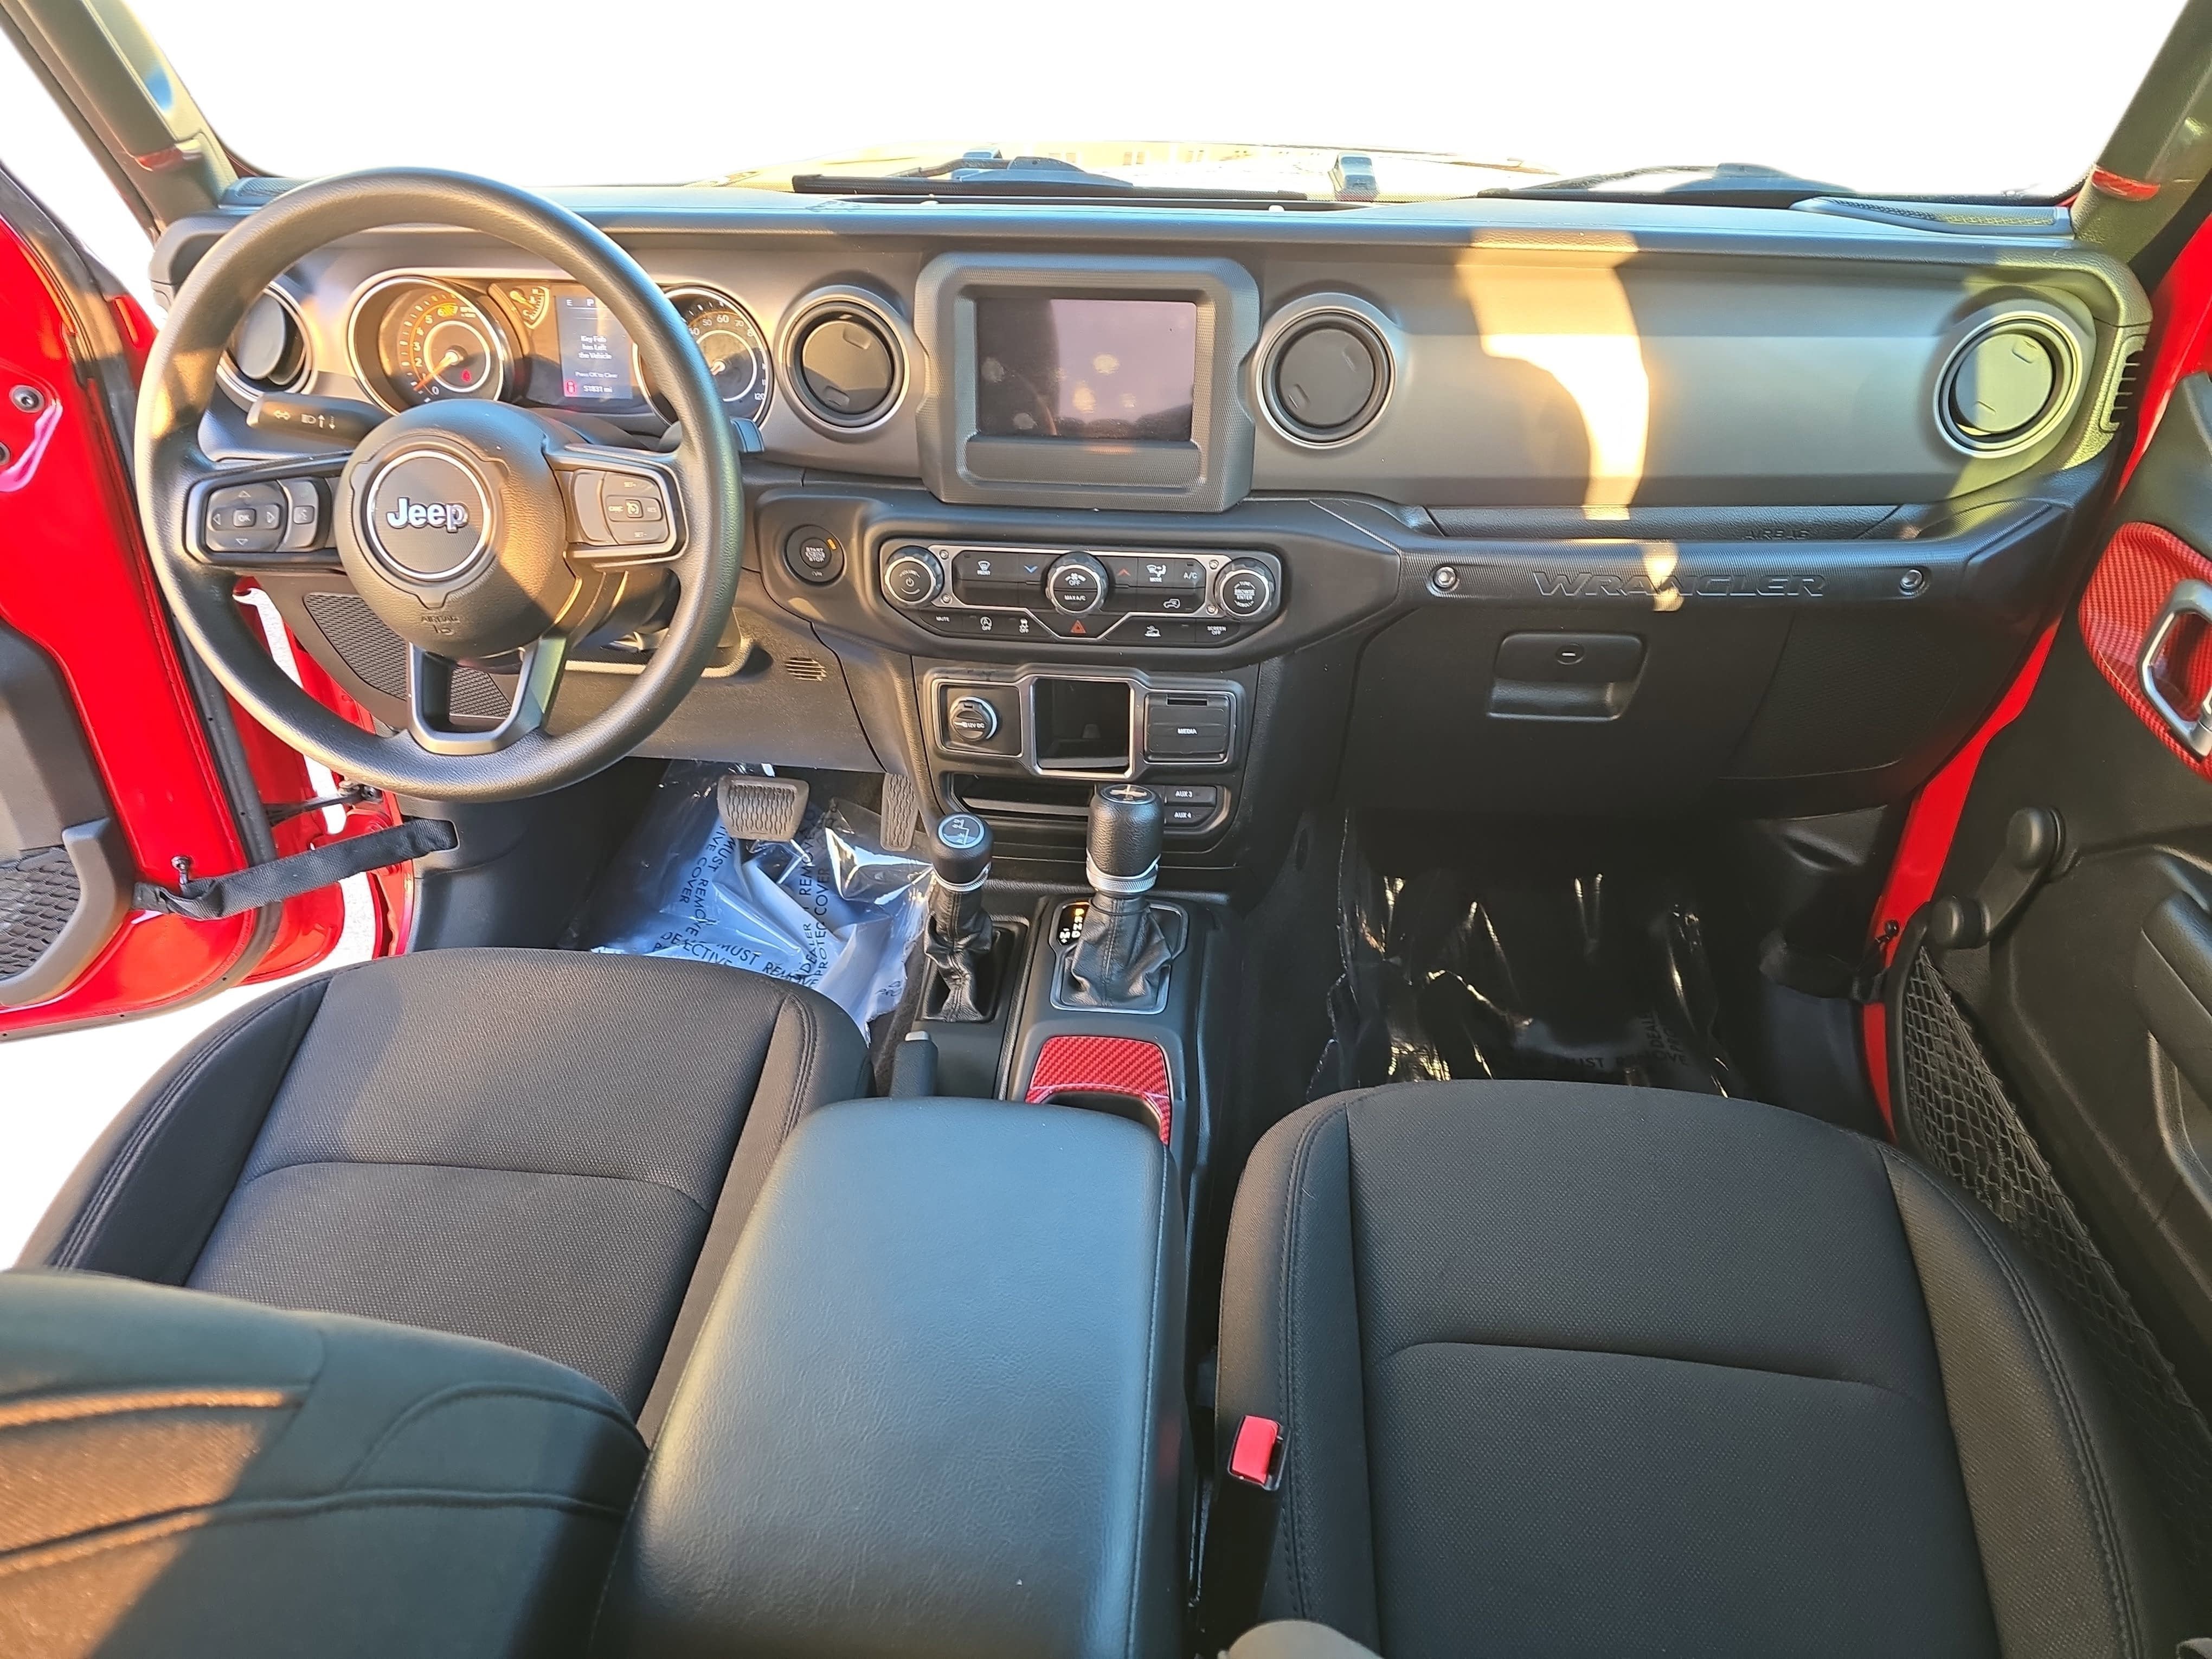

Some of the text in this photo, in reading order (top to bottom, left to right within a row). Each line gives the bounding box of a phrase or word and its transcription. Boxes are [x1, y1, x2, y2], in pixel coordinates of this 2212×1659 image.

[425, 314, 433, 324] 5
[716, 314, 729, 323] 60
[413, 342, 421, 351] 3
[414, 357, 423, 368] 2
[432, 386, 440, 395] 0
[237, 514, 252, 522] OK
[386, 497, 469, 533] Jeep
[1183, 571, 1198, 580] A/C
[1532, 571, 1825, 596] WRANGLER
[679, 857, 708, 904] COVER
[686, 837, 736, 937] MUST REMOVE
[814, 867, 831, 916] COVER
[1075, 908, 1084, 916] P
[1073, 923, 1083, 931] N
[1071, 930, 1081, 938] D
[800, 923, 818, 974] DEALER
